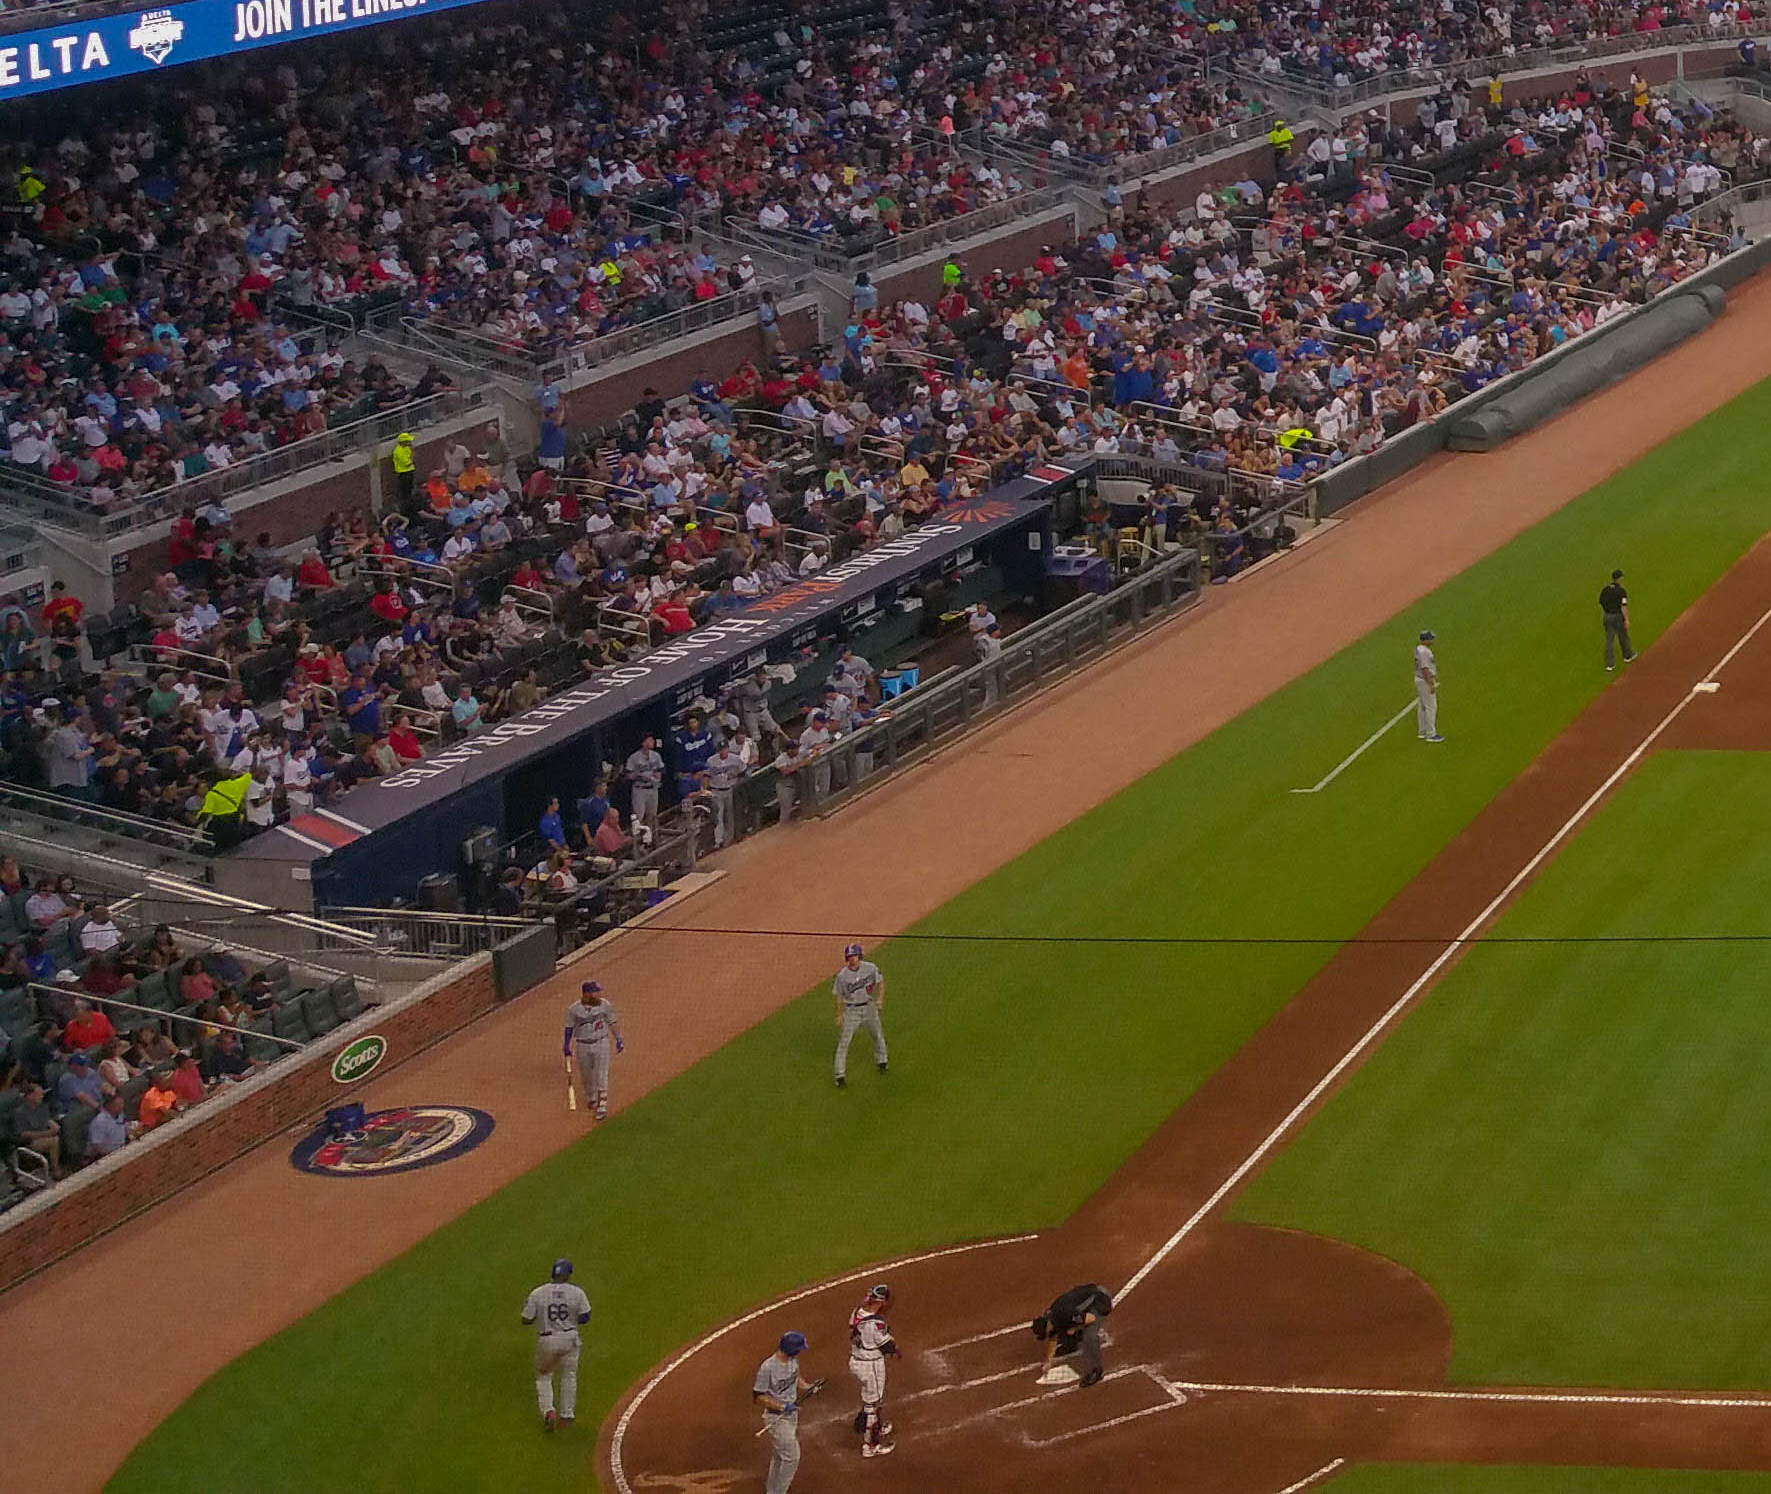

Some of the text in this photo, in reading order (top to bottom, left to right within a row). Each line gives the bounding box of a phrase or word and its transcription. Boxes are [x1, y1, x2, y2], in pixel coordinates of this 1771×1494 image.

[380, 618, 770, 788] HOME OF THE BRAVES
[340, 1043, 378, 1075] Scotts
[548, 1304, 568, 1322] 66
